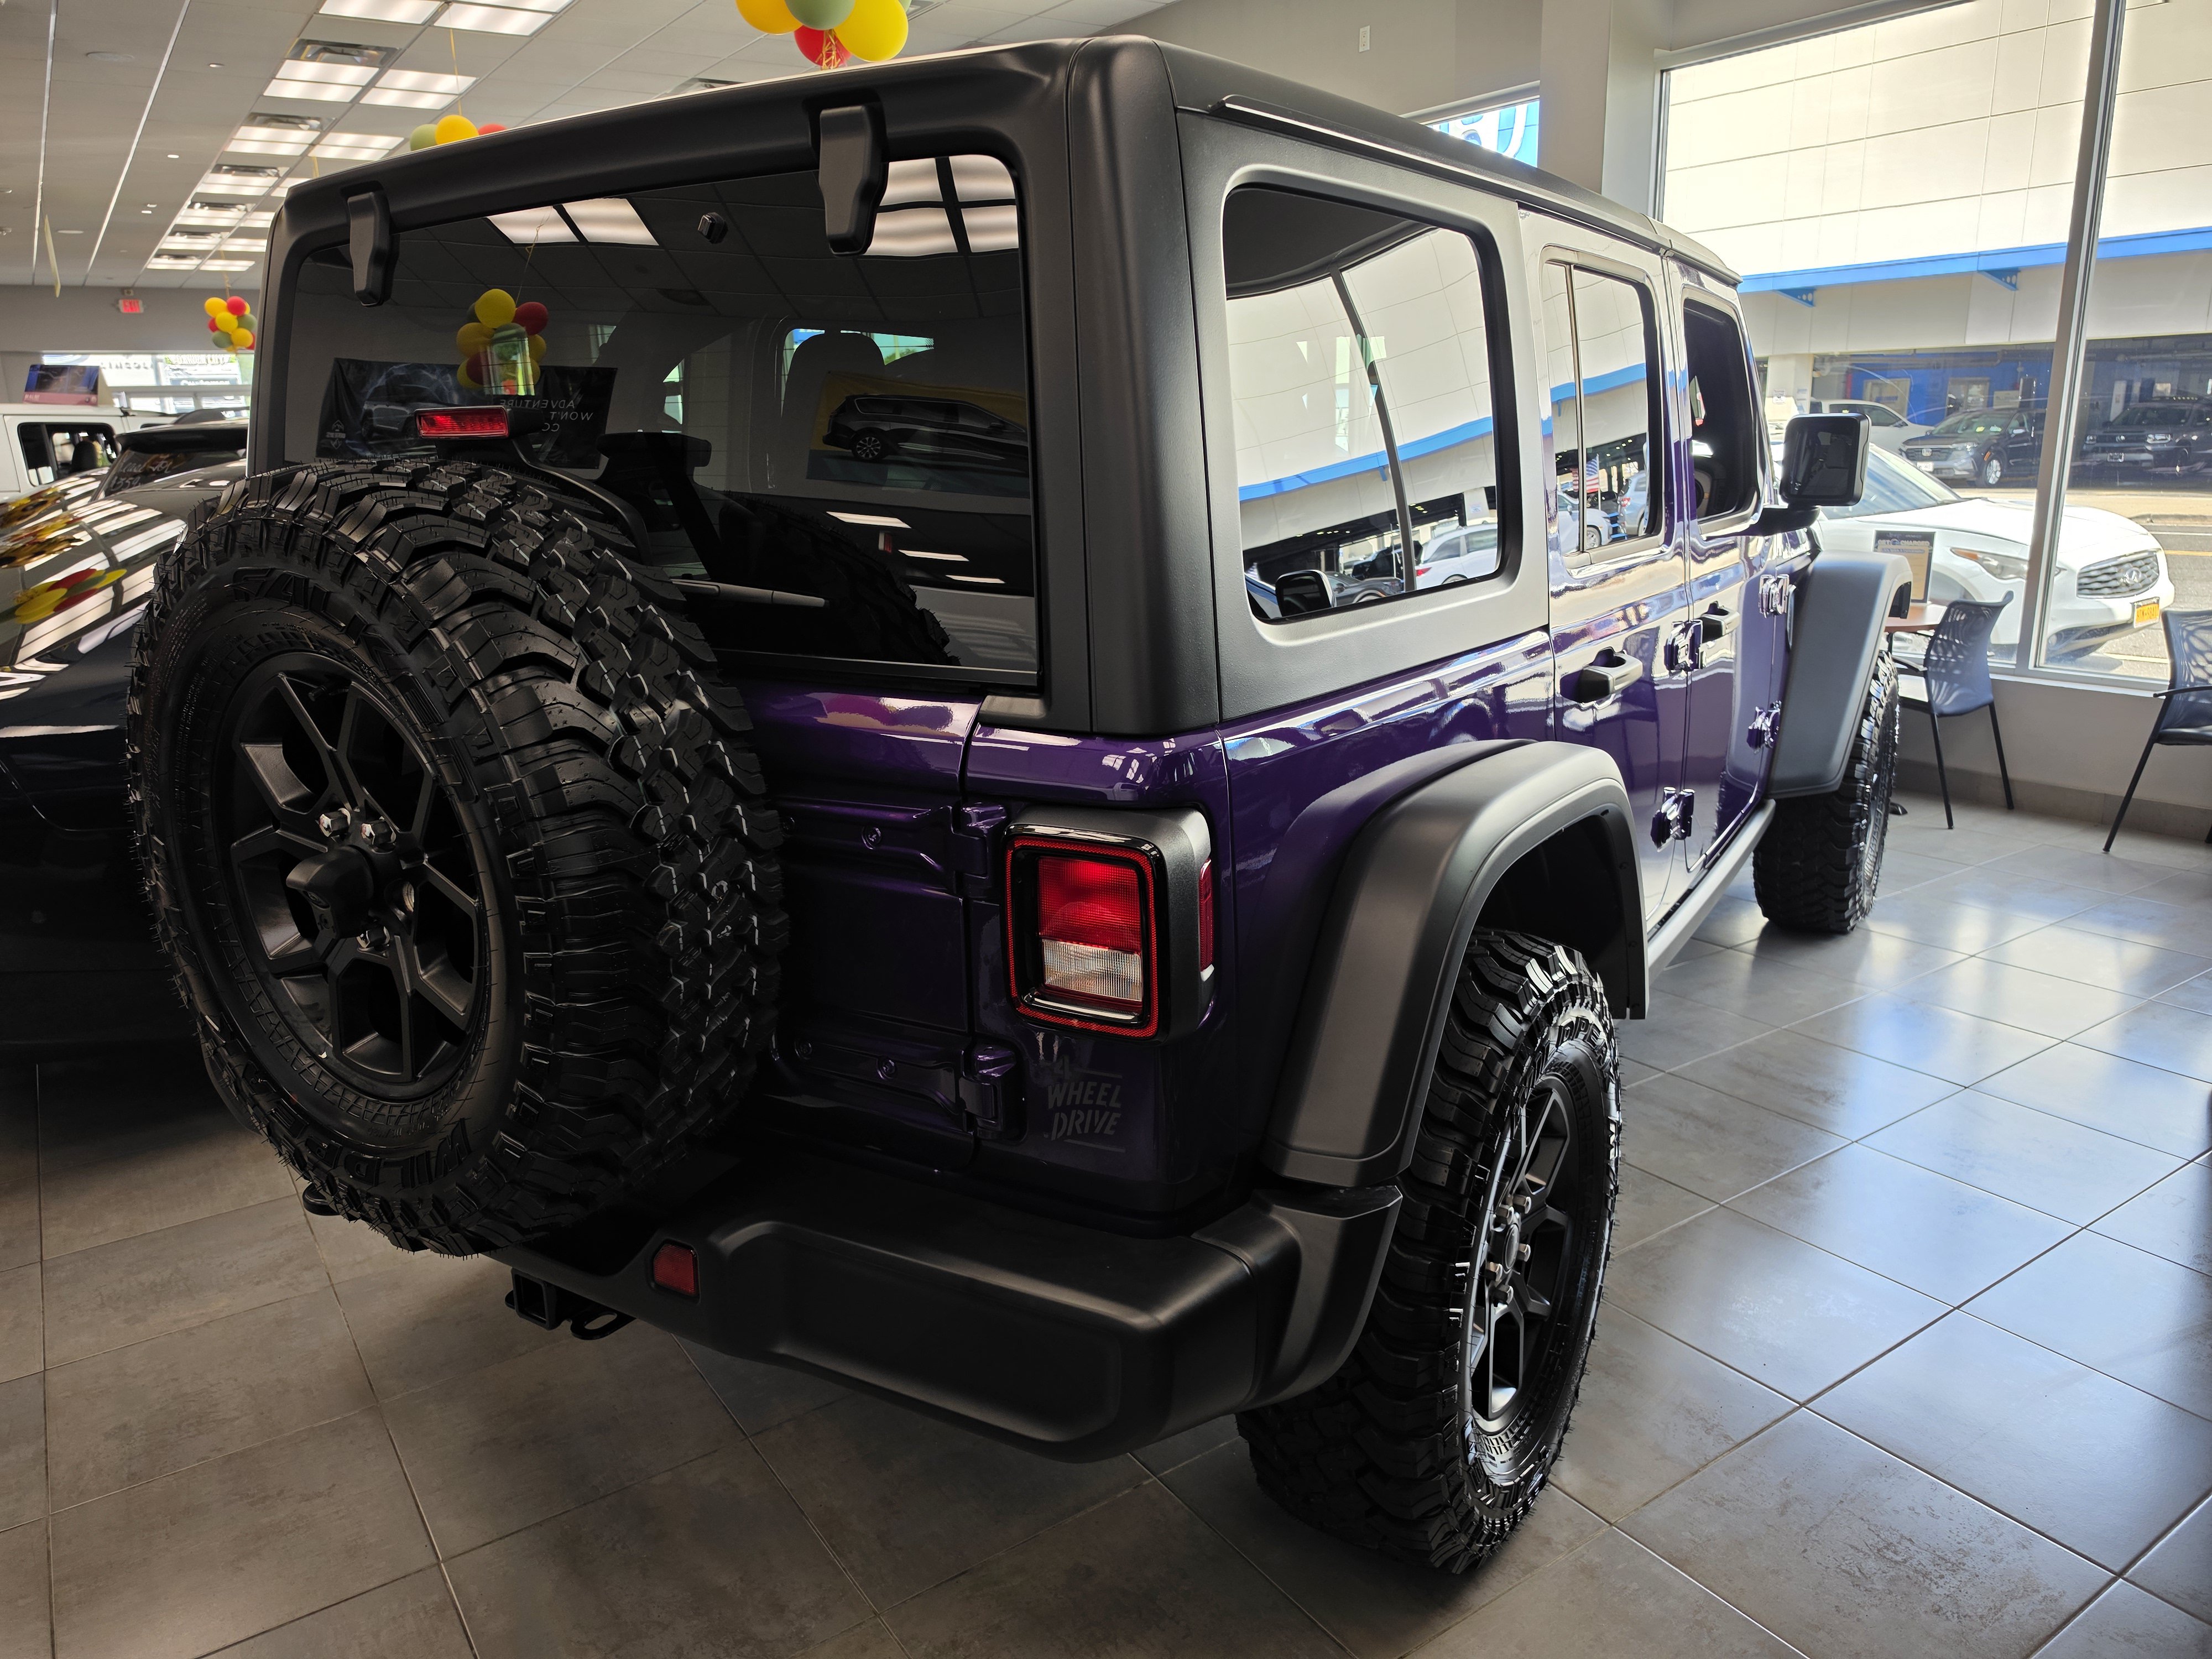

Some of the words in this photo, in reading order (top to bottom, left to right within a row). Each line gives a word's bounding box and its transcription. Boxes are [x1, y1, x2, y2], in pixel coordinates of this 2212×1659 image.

[123, 300, 140, 312] EXIT
[232, 566, 481, 802] FALKEN
[1048, 1081, 1122, 1109] WHEEL
[1051, 1109, 1121, 1141] DRIVE
